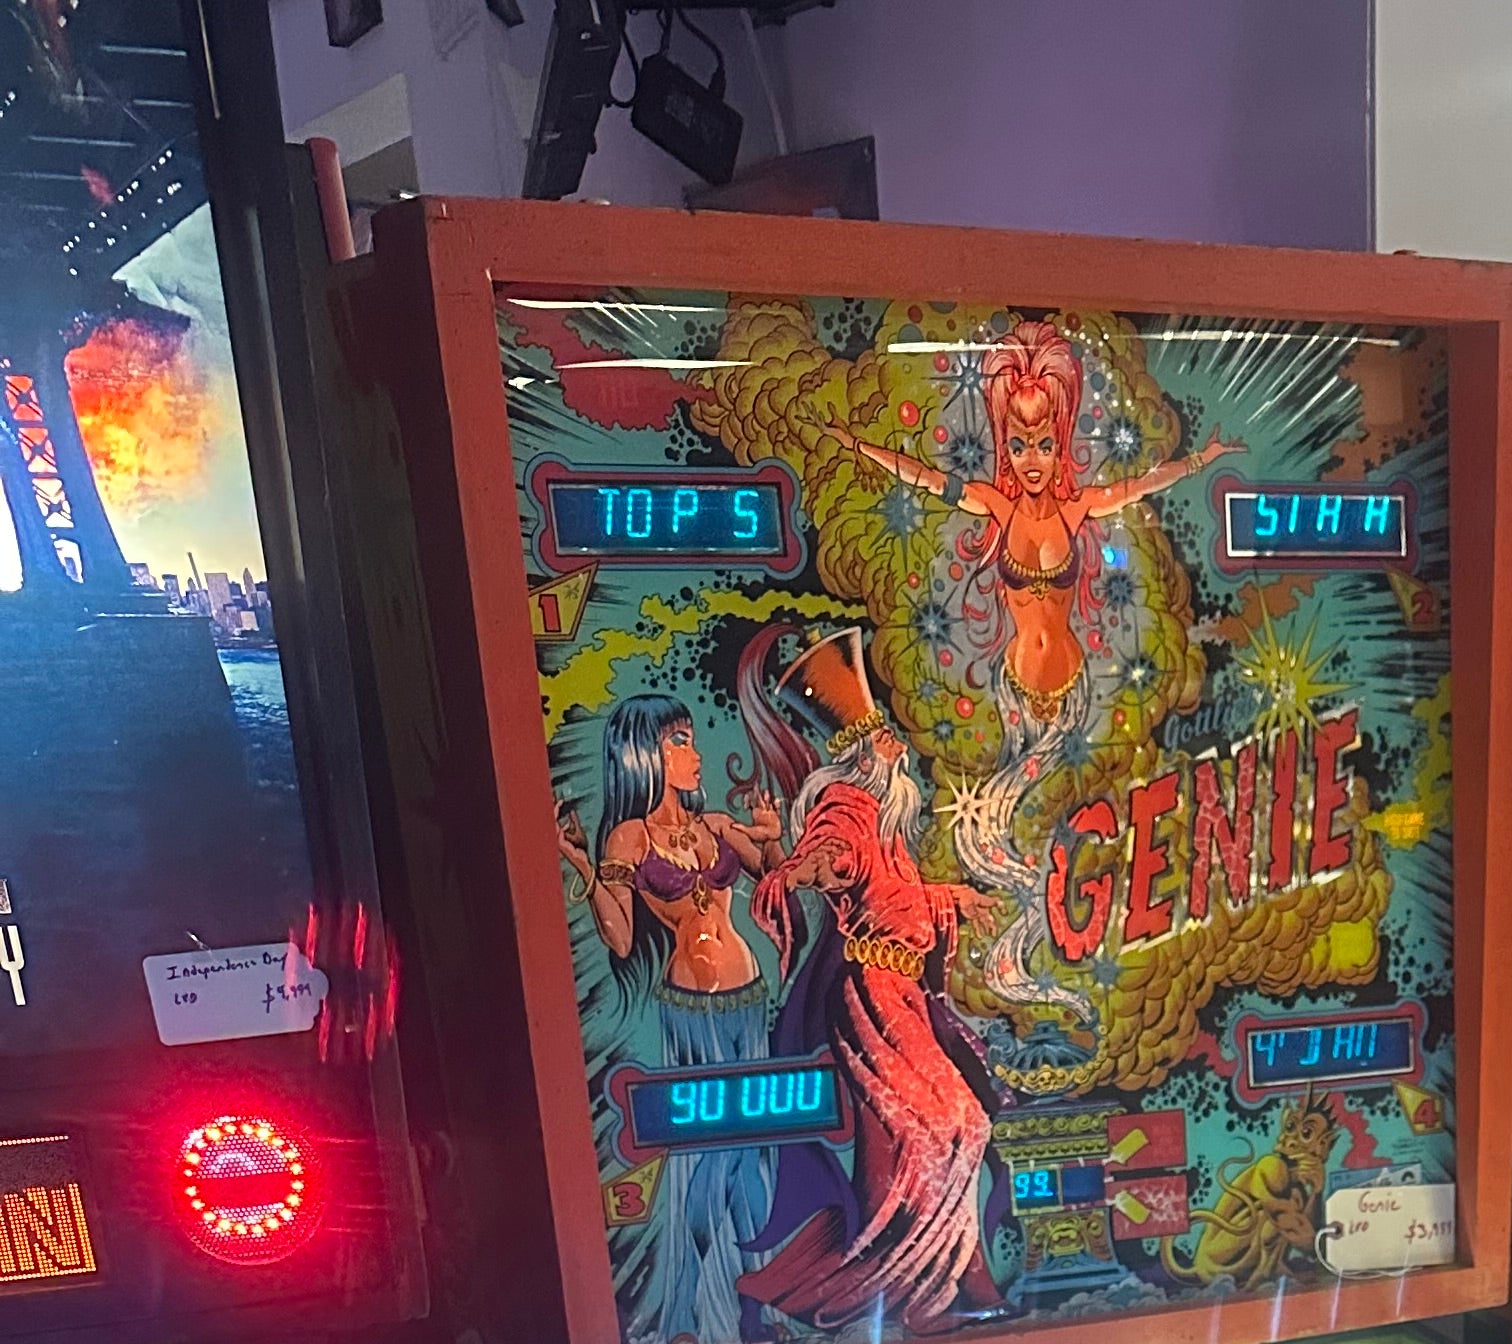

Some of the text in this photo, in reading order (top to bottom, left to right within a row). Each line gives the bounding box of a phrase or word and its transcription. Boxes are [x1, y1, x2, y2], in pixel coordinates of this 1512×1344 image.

[538, 593, 561, 633] 1
[1411, 591, 1433, 619] 2
[1045, 708, 1362, 964] GENIE
[262, 951, 289, 971] Day
[1414, 1099, 1440, 1128] 4
[612, 1181, 646, 1217] 3
[1358, 1190, 1401, 1214] Genie
